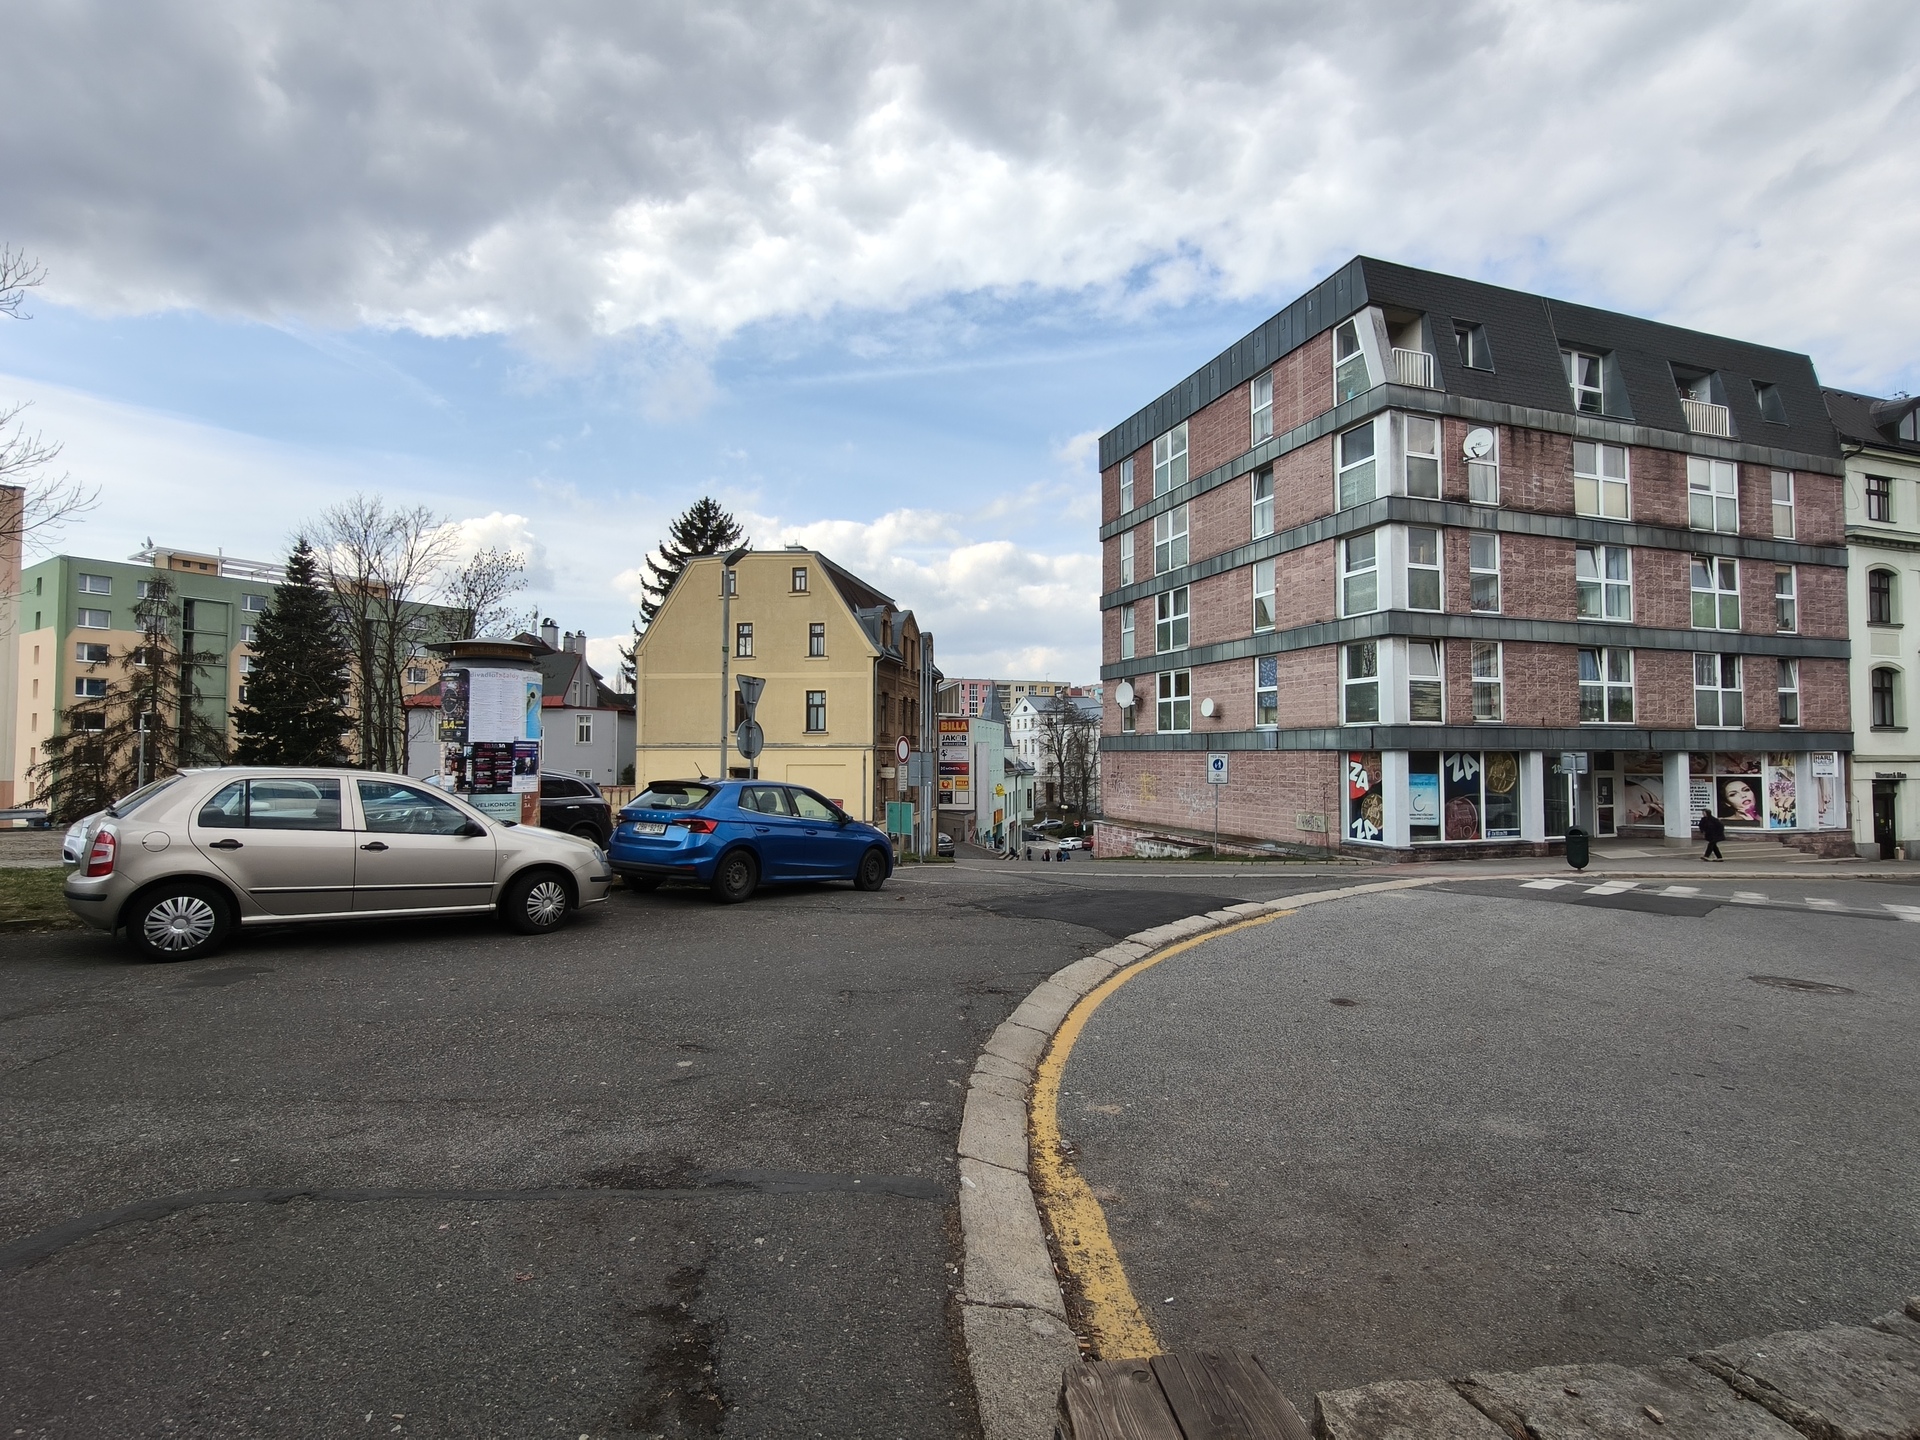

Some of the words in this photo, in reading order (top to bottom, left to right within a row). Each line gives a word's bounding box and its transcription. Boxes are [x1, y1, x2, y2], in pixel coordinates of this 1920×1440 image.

[941, 721, 967, 731] BILLA
[1349, 761, 1369, 791] ZA
[1445, 752, 1480, 782] ZA
[1351, 818, 1378, 840] ZA
